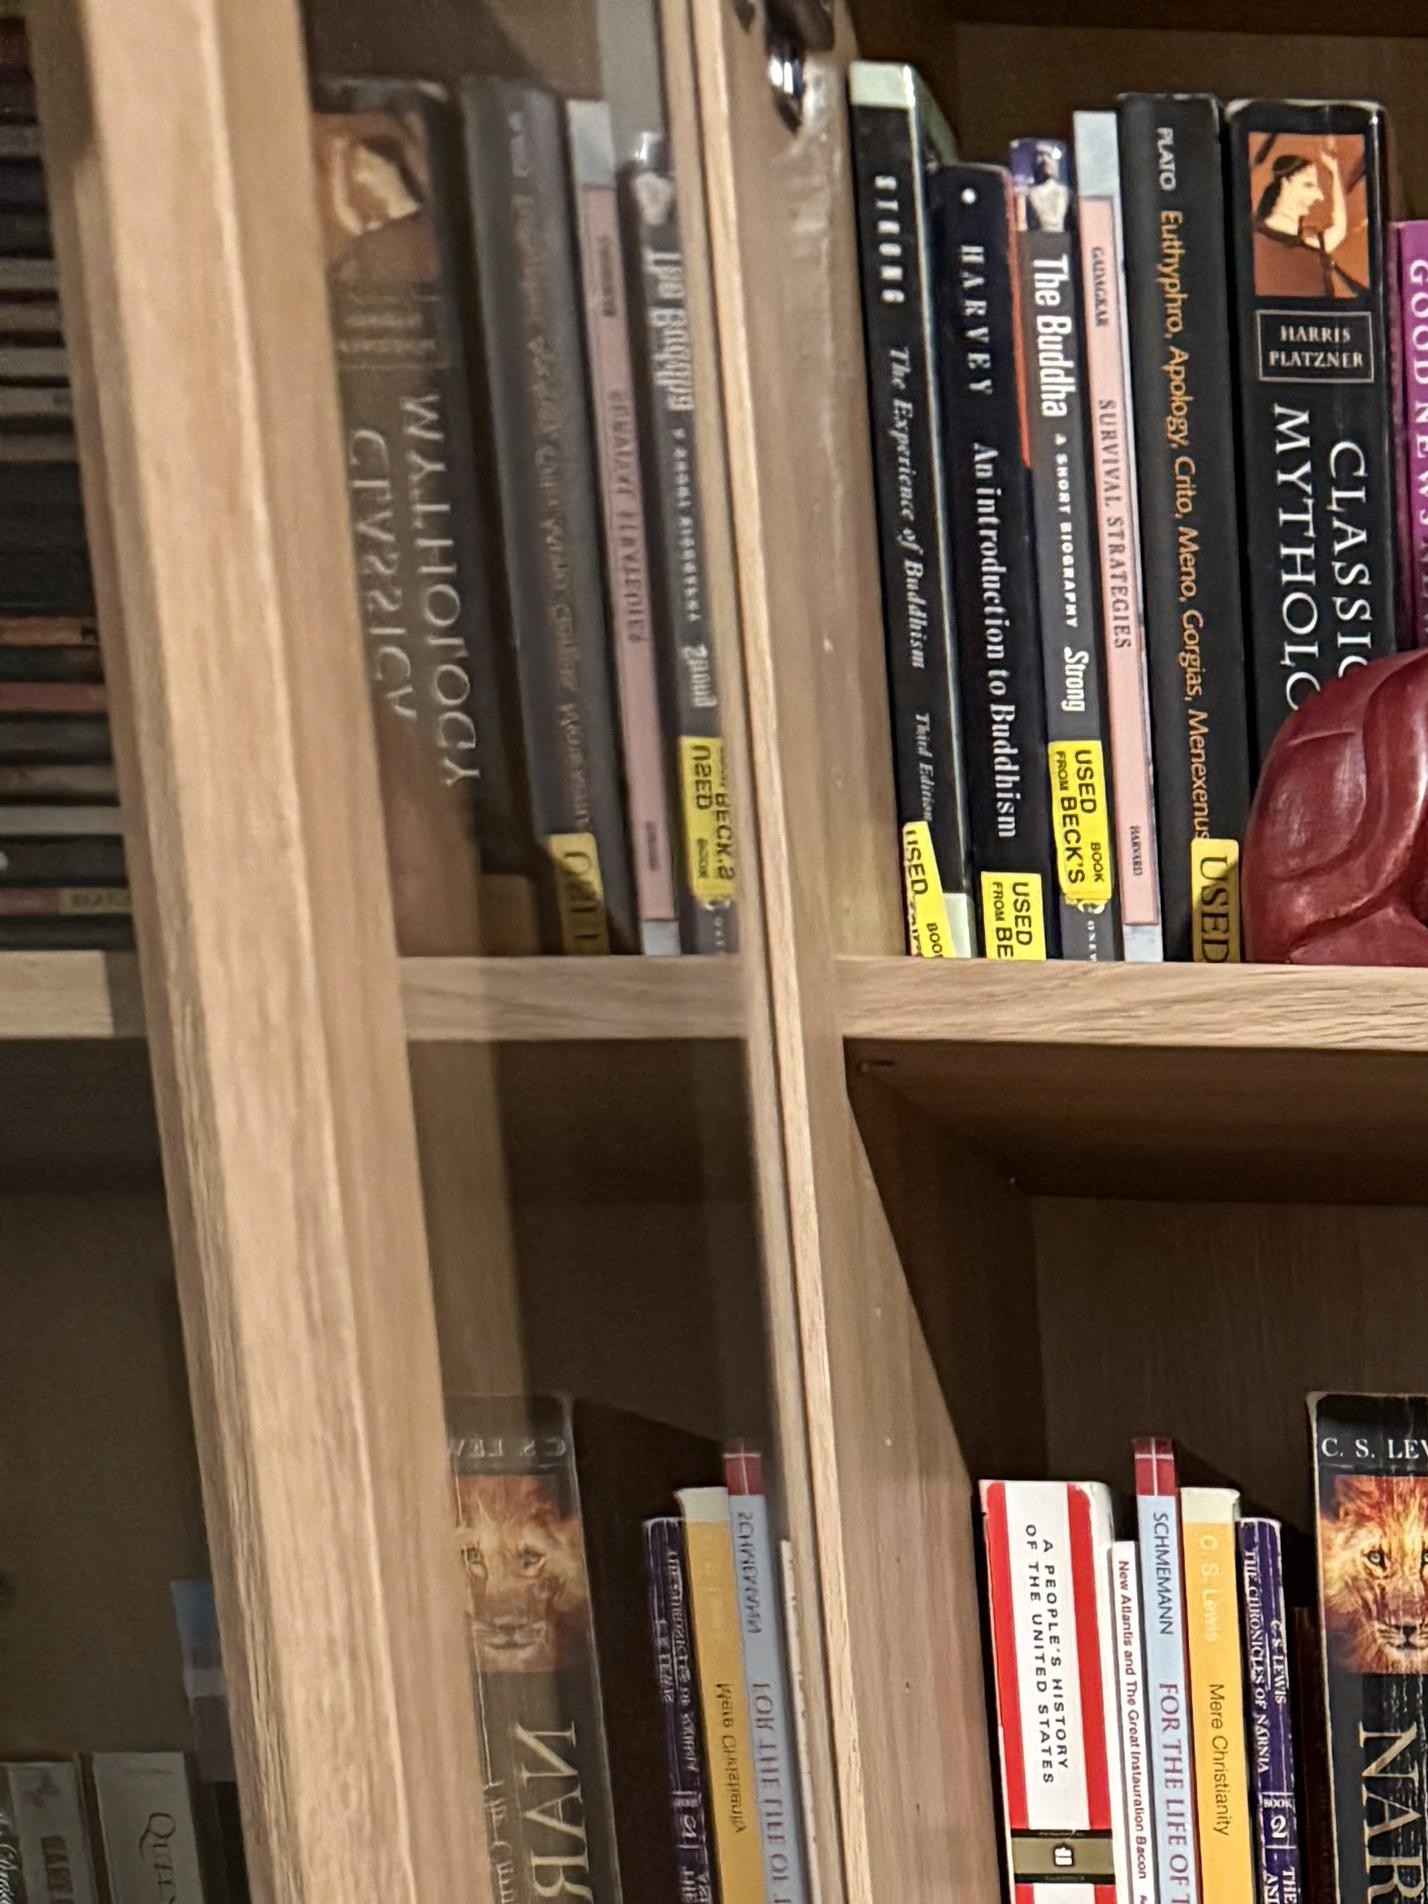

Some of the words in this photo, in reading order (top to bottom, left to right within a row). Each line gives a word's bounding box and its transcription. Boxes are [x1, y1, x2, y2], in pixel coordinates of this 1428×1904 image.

[959, 244, 993, 394] HARVEY
[1032, 254, 1069, 306] The
[1037, 315, 1077, 418] Buddha
[974, 440, 998, 479] An
[974, 488, 1008, 660] introduction
[987, 670, 1006, 697] to
[988, 704, 1022, 839] Buddhism
[1320, 1438, 1345, 1459] C.
[1355, 1438, 1379, 1459] S.
[1026, 1524, 1038, 1556] OF
[1042, 1538, 1056, 1553] A
[1028, 1561, 1041, 1604] THE
[1045, 1564, 1062, 1668] PEOPLE'S
[1032, 1613, 1048, 1694] UNITED
[1037, 1703, 1055, 1785] STATES
[1053, 1677, 1069, 1771] HISTORY
